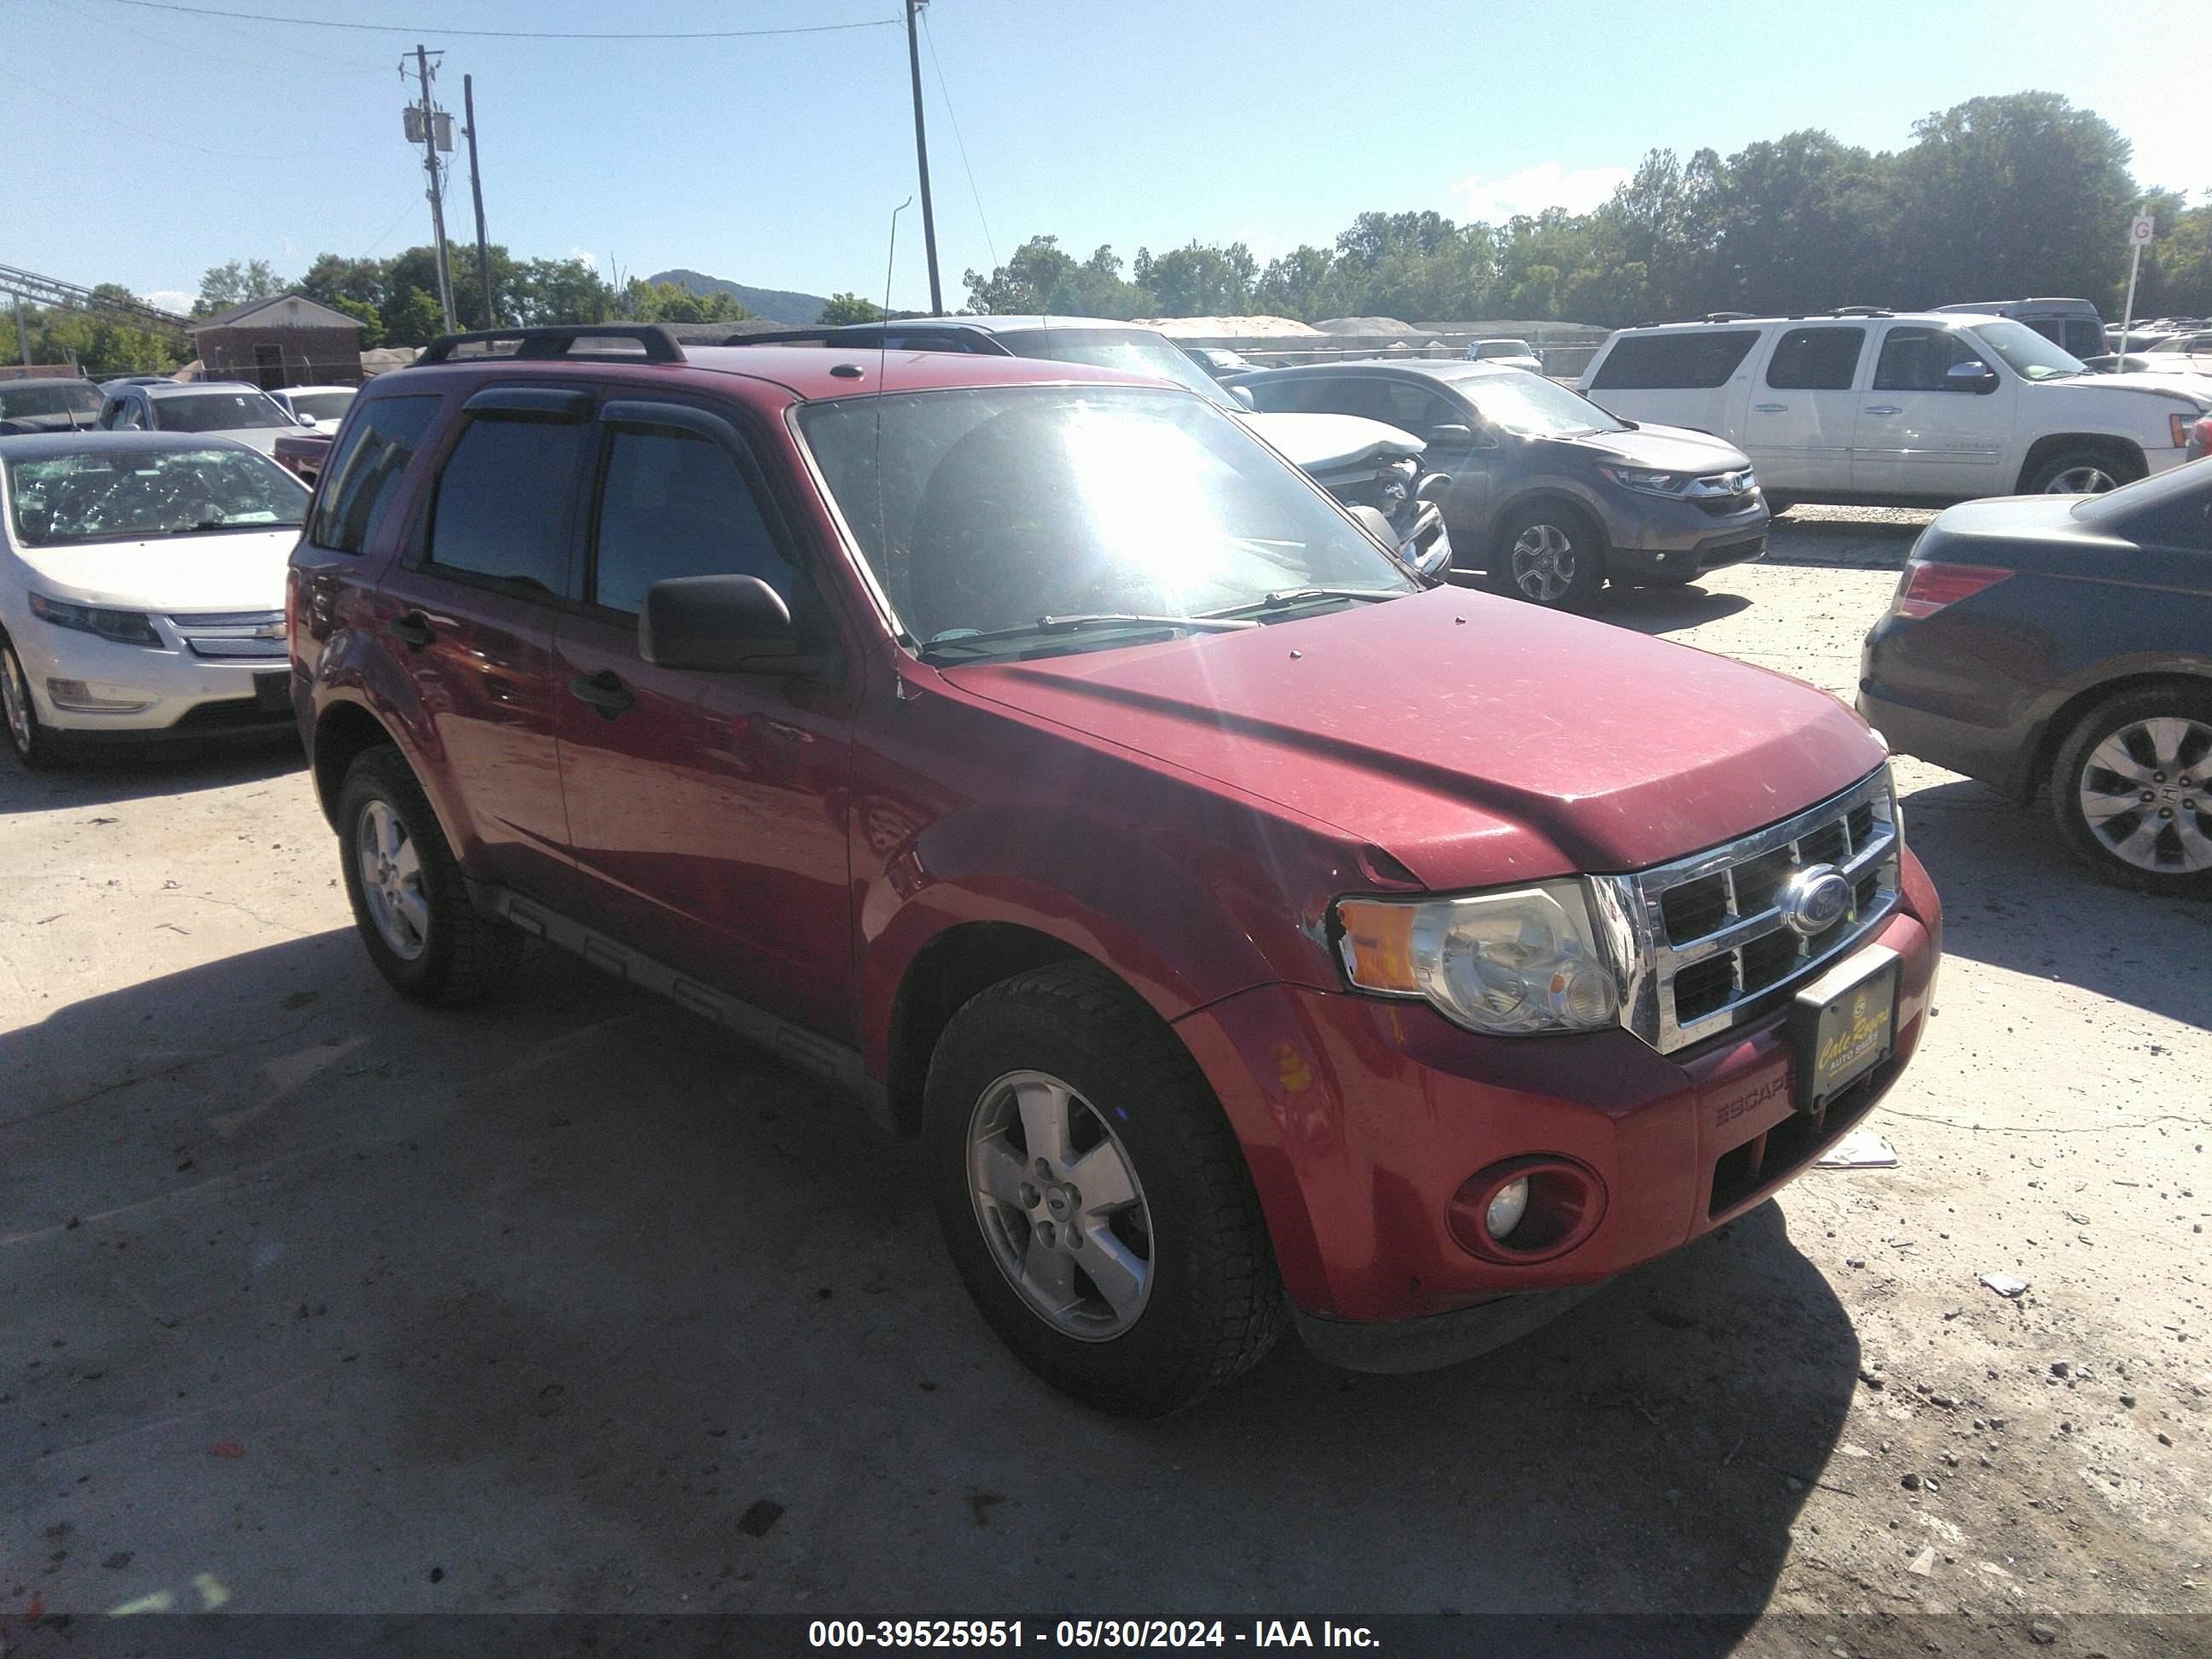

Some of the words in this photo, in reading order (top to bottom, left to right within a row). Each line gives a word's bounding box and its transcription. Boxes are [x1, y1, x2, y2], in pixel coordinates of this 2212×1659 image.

[2135, 221, 2150, 239] G
[1830, 1050, 1854, 1070] AUTO
[1855, 1030, 1878, 1051] SALES
[1715, 1070, 1796, 1127] ESCAPE
